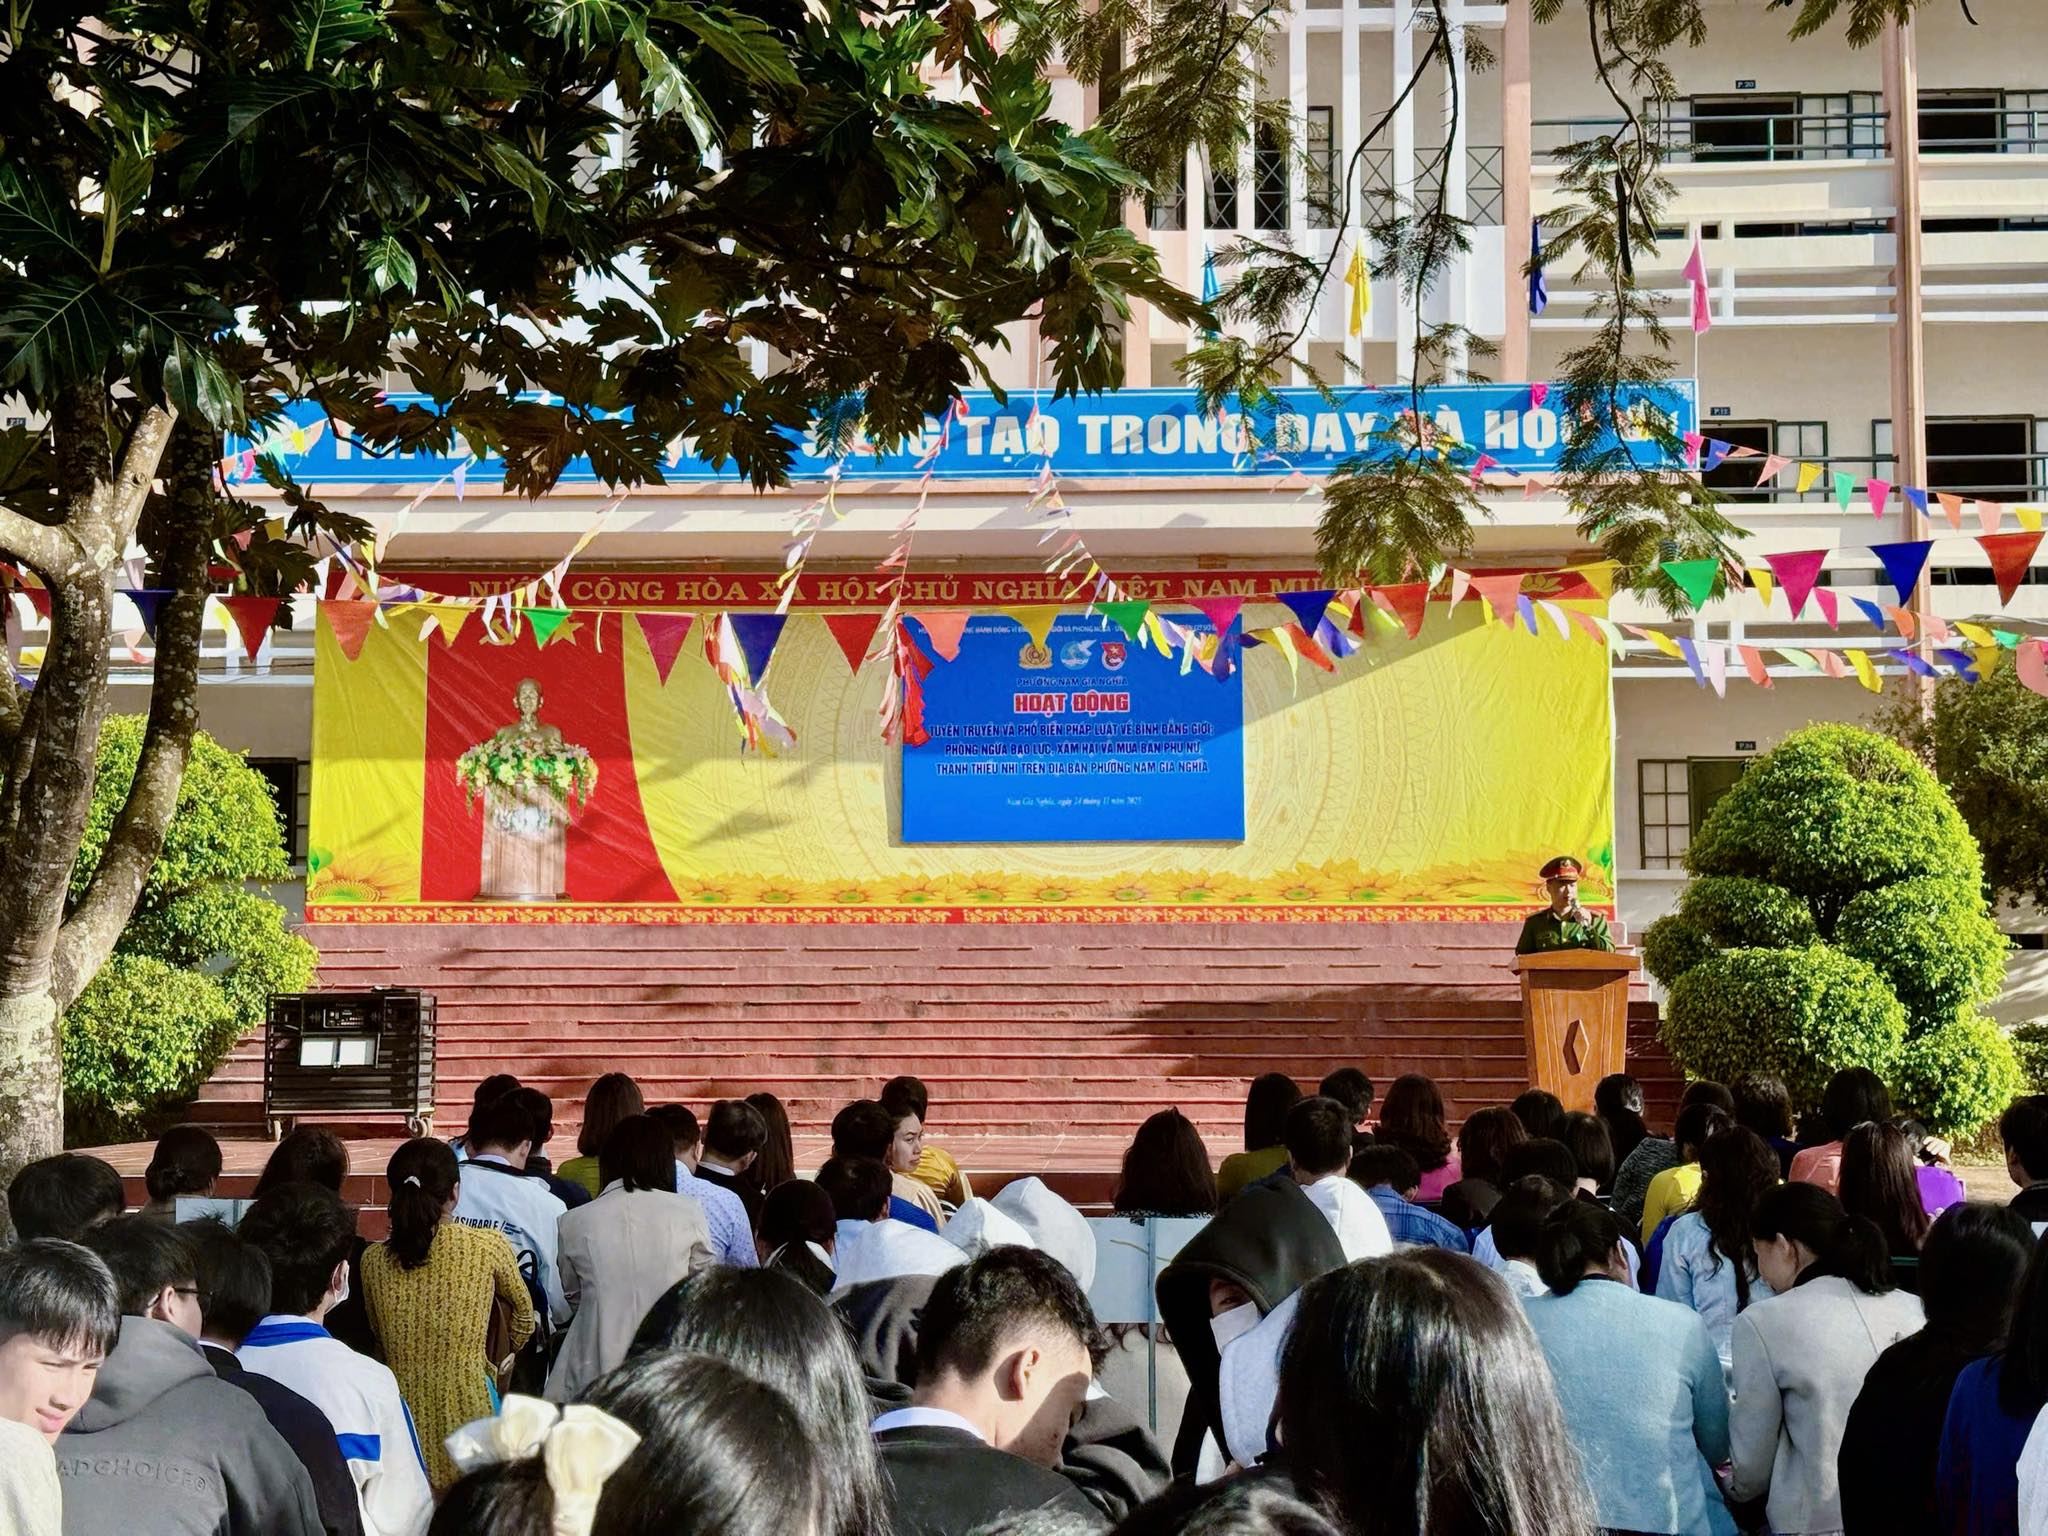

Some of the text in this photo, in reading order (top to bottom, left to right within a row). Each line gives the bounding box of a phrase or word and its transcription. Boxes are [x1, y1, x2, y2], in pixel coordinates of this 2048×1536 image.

[966, 415, 1060, 463] TẠO
[1078, 413, 1254, 455] TRONG
[1275, 411, 1377, 460] DẠY
[571, 576, 665, 605] CỘNG
[676, 576, 749, 600] HÒA
[817, 576, 878, 605] HỘI
[890, 575, 960, 600] CHỦ
[973, 576, 1082, 600] NGHĨA
[1183, 578, 1257, 597] NAM
[1014, 689, 1131, 718] HOẠT ĐỘNG
[1001, 721, 1015, 737] VÀ
[944, 741, 979, 757] PHÒNG
[1009, 743, 1031, 759] BẠO
[1080, 742, 1099, 759] HẠI
[1100, 738, 1114, 755] VÀ
[1115, 742, 1138, 755] MUA
[936, 762, 969, 776] THANH
[1001, 762, 1020, 776] NHI
[1021, 761, 1047, 775] TRÊN
[1132, 761, 1157, 774] NAM
[1158, 761, 1177, 774] GIA
